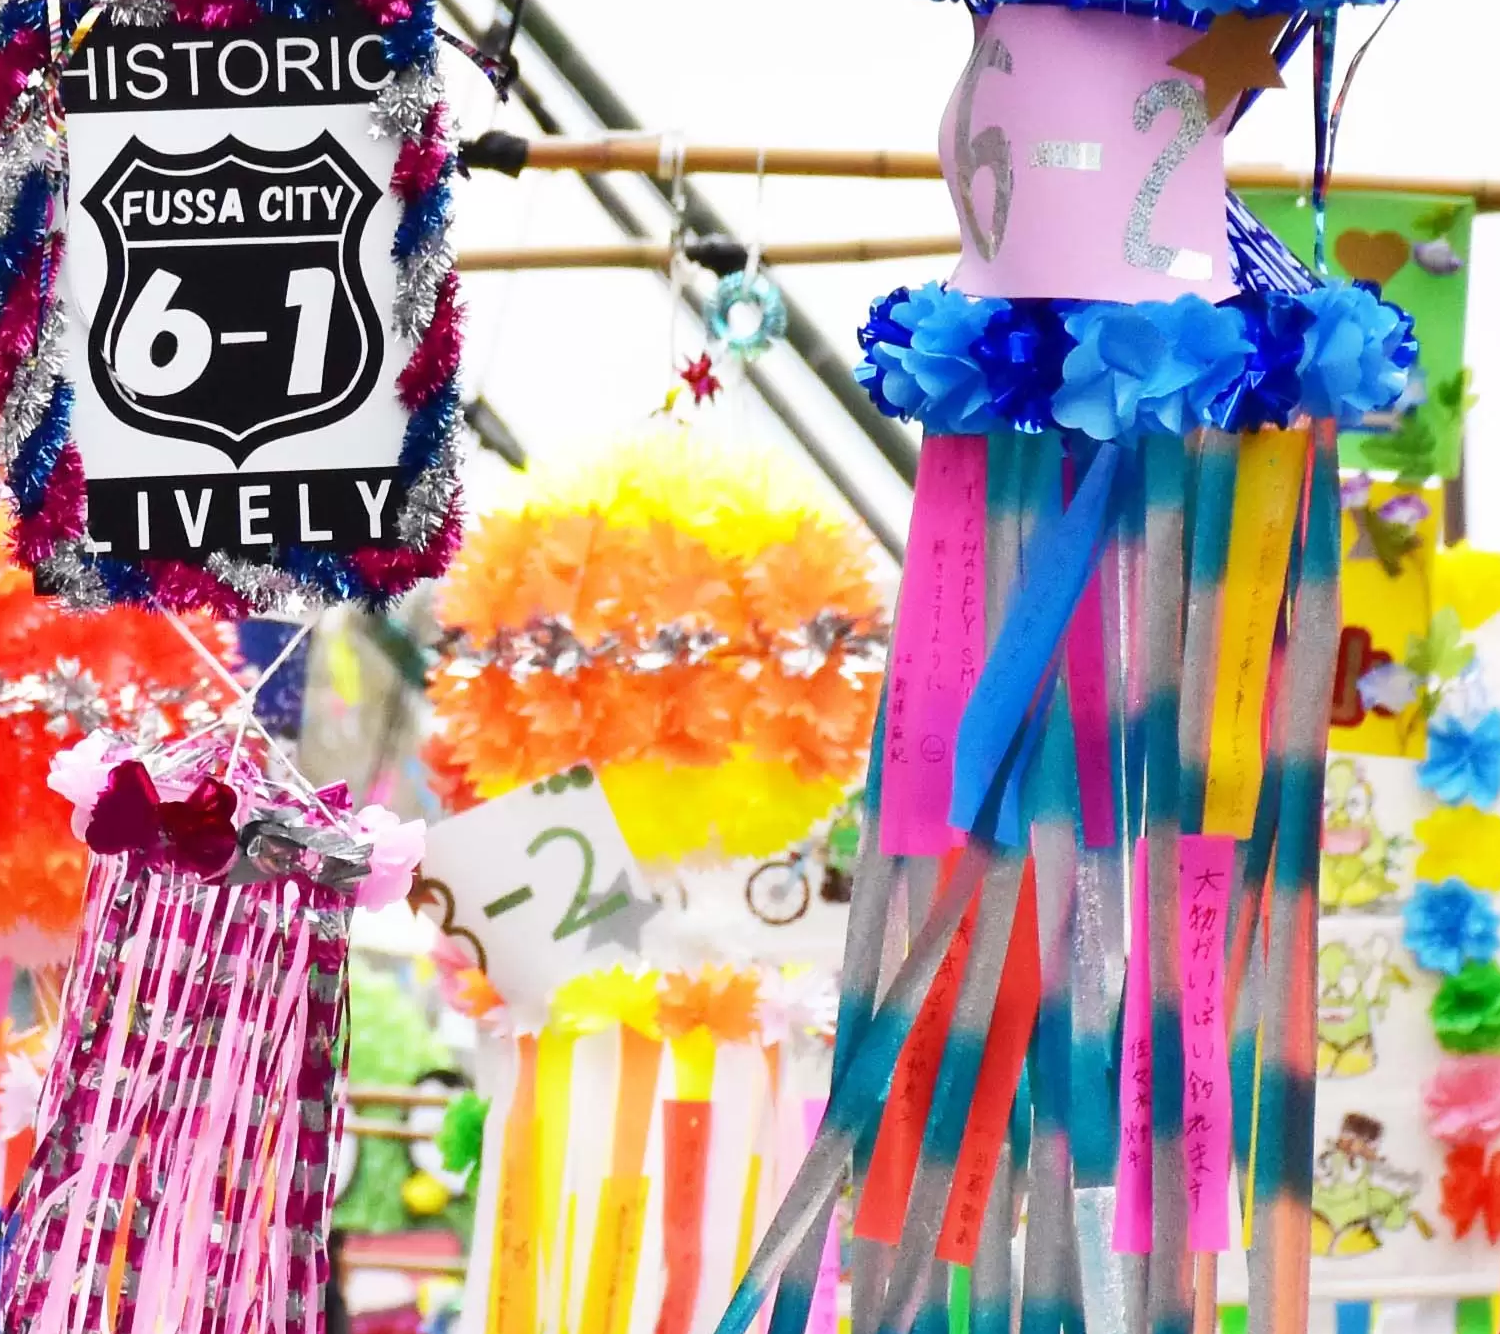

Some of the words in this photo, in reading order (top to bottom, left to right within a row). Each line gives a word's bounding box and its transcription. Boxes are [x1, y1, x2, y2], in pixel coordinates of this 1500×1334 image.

[122, 186, 245, 227] FUSSA
[258, 183, 344, 223] CITY
[954, 38, 1213, 281] 6-2
[114, 267, 336, 398] 6-1
[87, 479, 393, 554] IVELY
